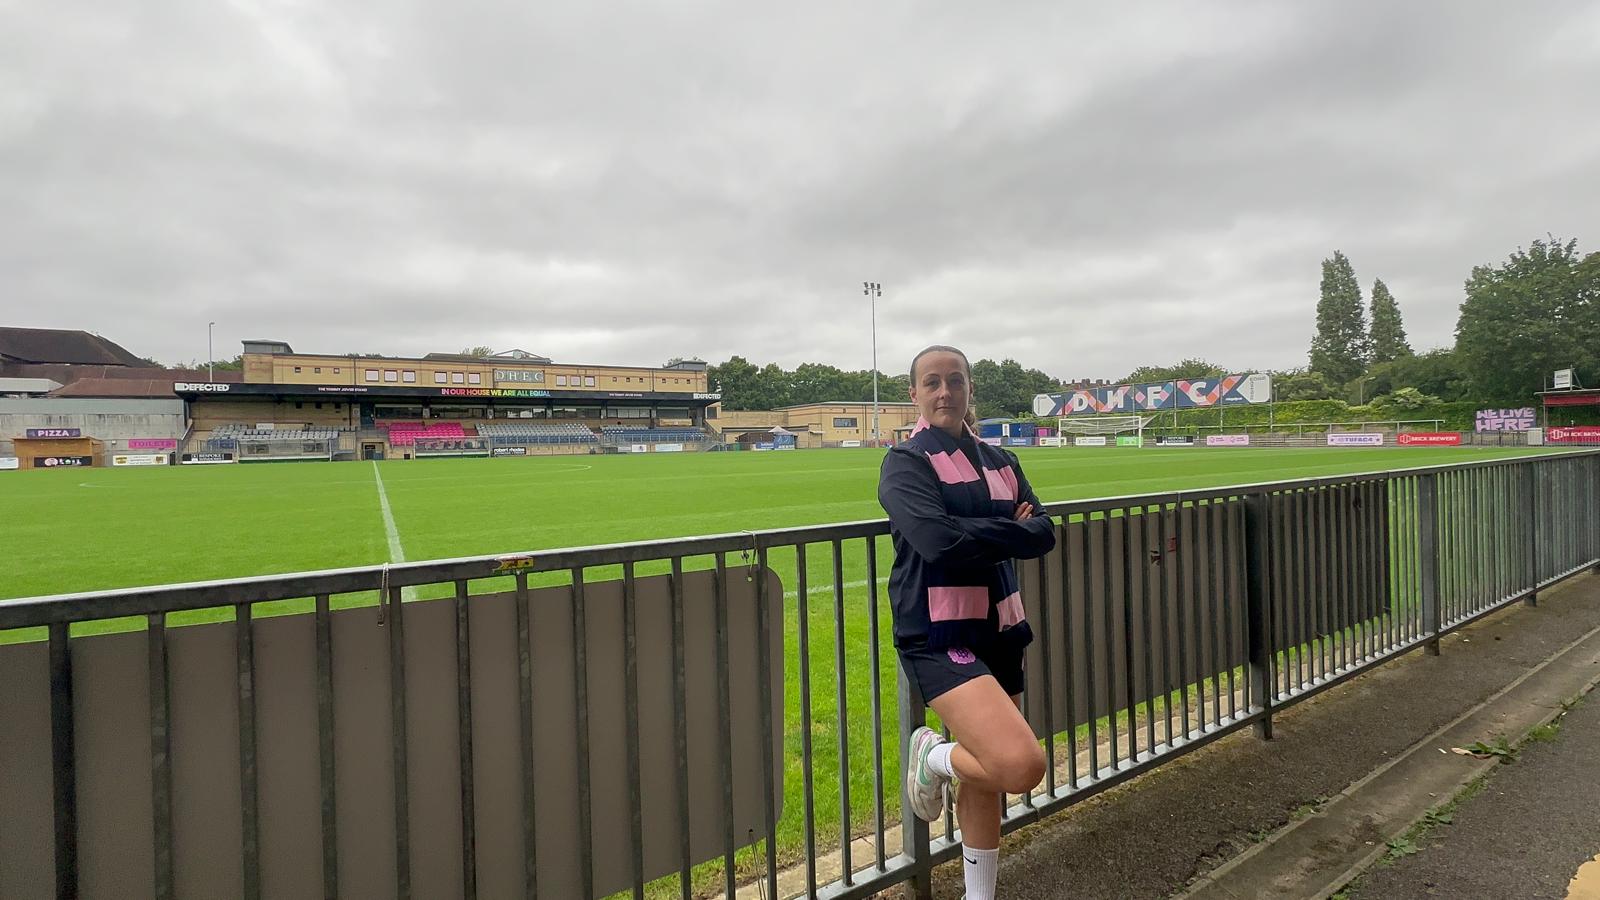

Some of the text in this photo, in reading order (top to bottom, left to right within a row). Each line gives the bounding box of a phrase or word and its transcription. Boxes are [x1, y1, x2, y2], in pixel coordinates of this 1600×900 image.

[182, 383, 230, 392] DEFECTED
[450, 388, 466, 396] OUR
[502, 389, 516, 397] ARE
[1476, 407, 1534, 419] WE LIVE
[1475, 418, 1534, 433] HERE
